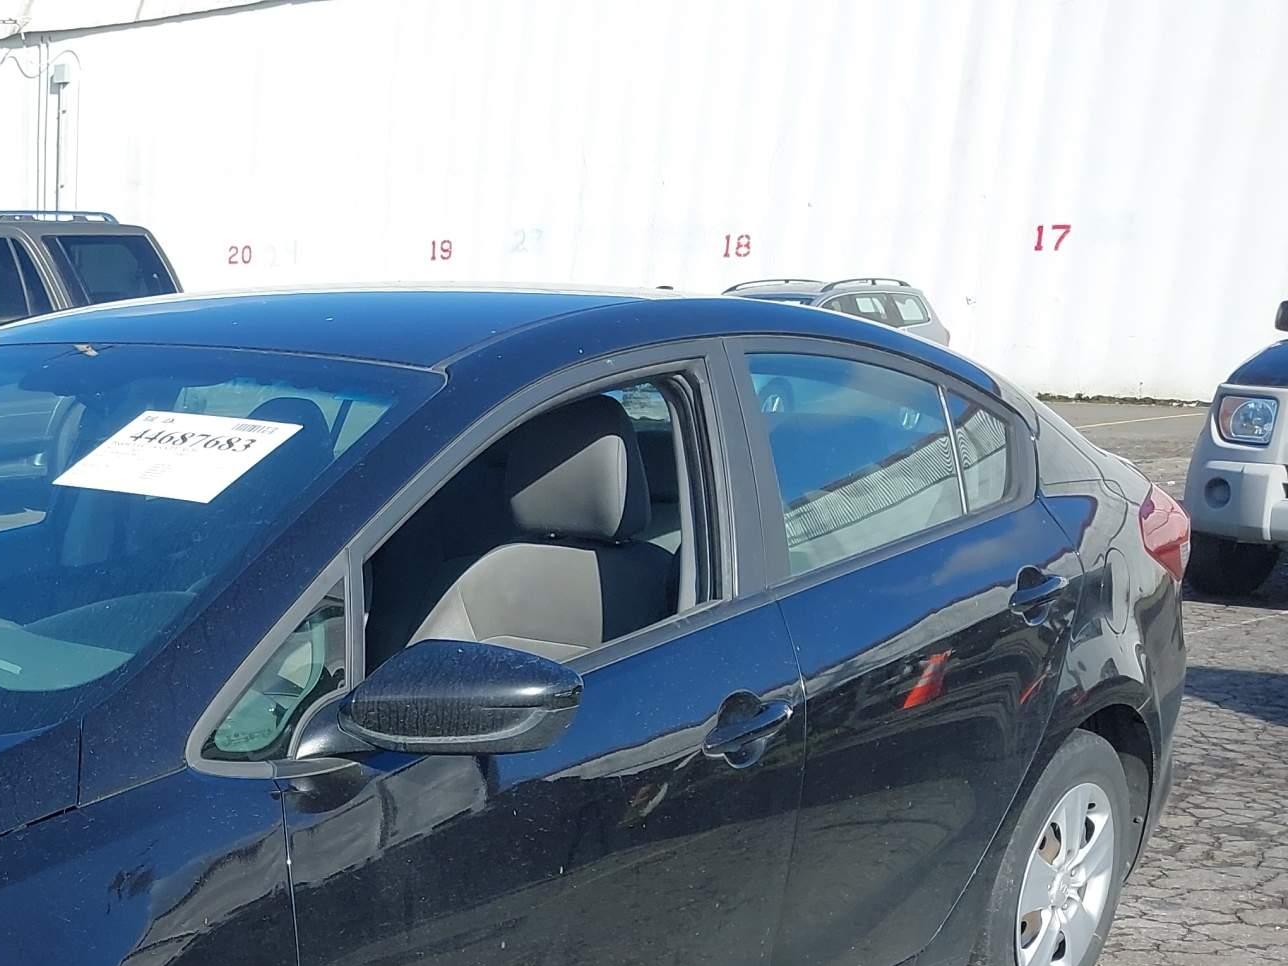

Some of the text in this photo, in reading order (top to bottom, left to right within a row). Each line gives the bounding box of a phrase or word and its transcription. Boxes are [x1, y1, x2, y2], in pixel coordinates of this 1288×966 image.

[723, 234, 752, 258] 18
[1034, 224, 1072, 251] 17
[227, 244, 252, 264] 20
[430, 240, 453, 261] 19
[129, 428, 257, 453] 44687683
